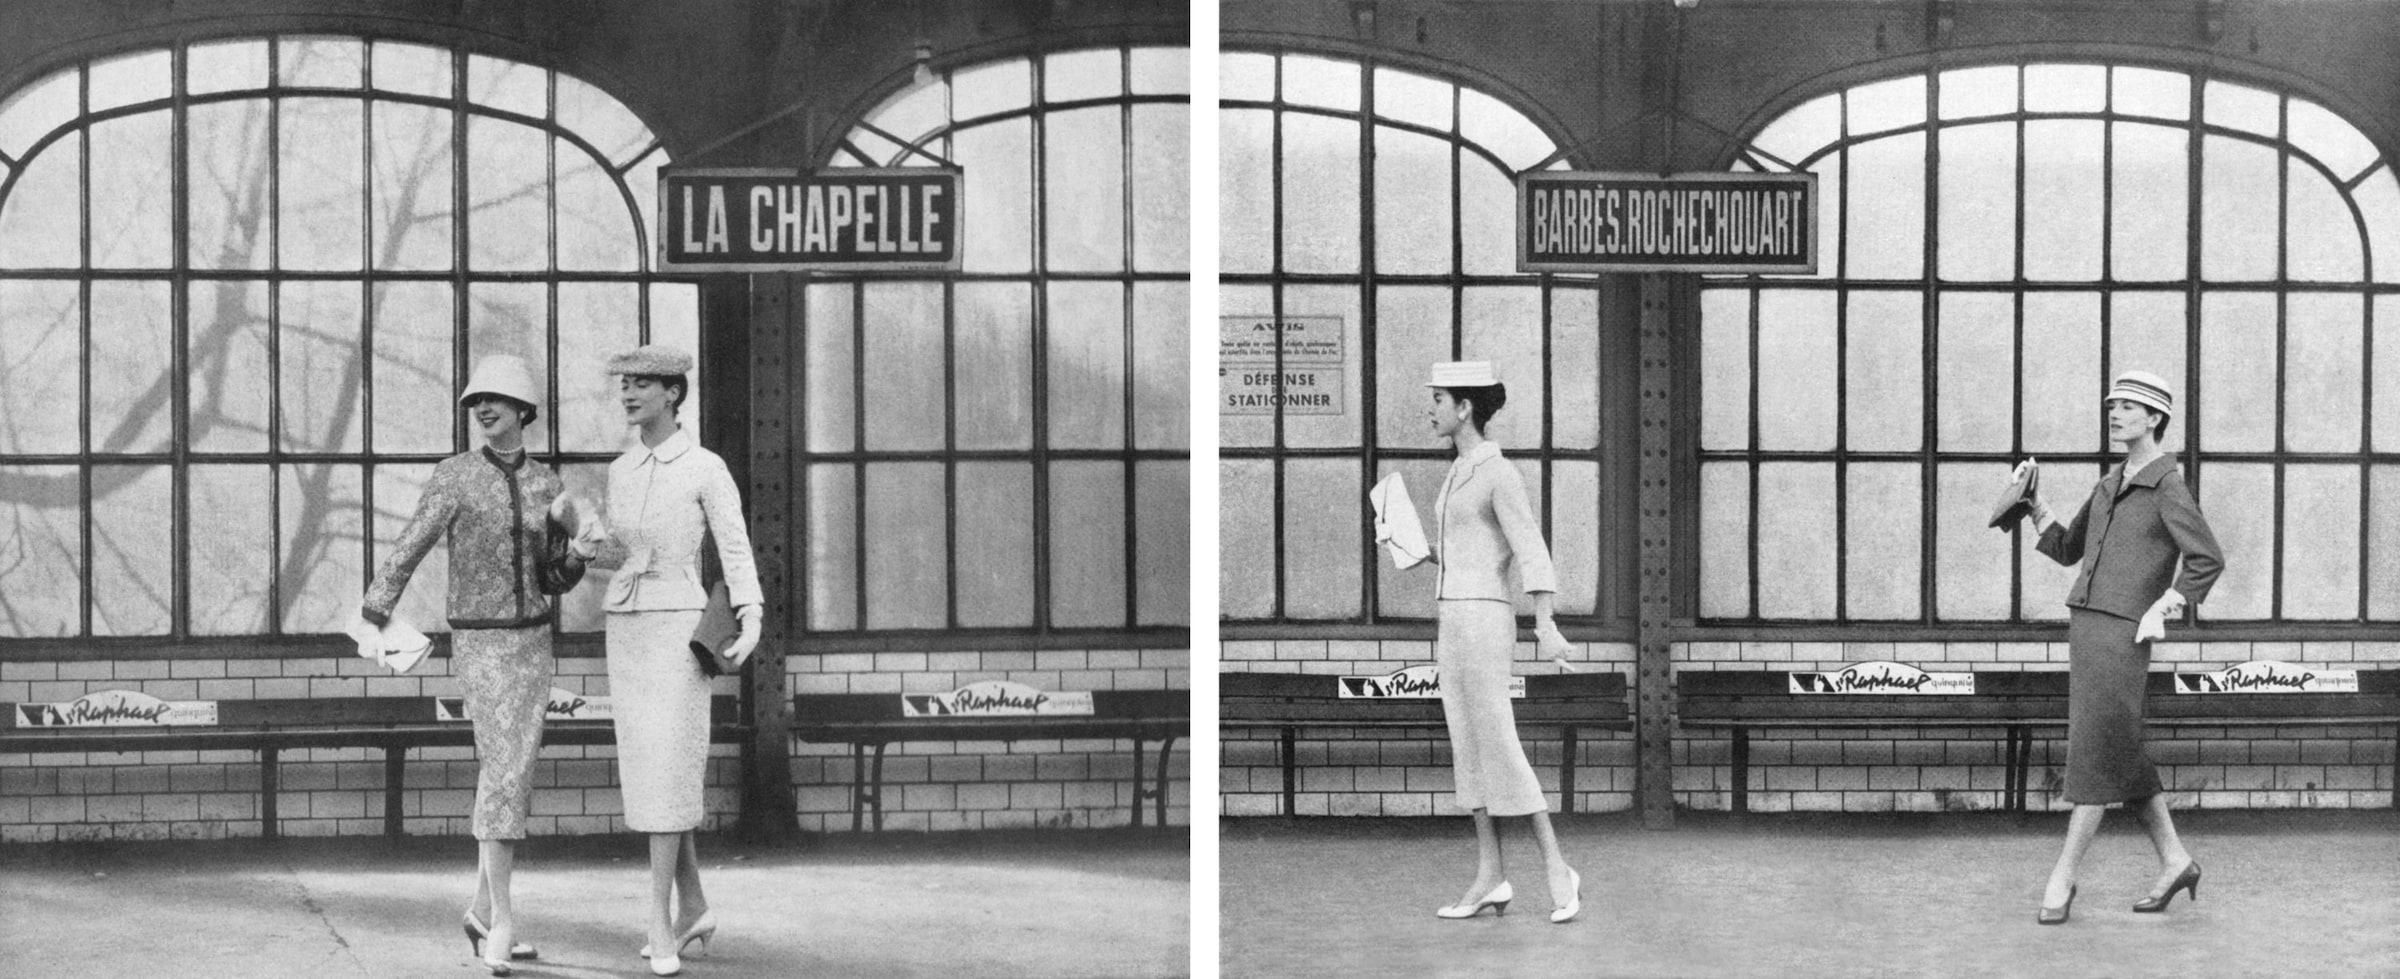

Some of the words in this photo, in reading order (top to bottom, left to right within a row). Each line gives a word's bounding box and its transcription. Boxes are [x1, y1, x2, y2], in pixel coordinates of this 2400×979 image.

[684, 185, 729, 252] LA
[750, 185, 942, 252] CHAPELLE
[1244, 371, 1315, 386] DÉFENSE
[1228, 394, 1330, 407] STATIONNER
[1392, 672, 1440, 696] Raph
